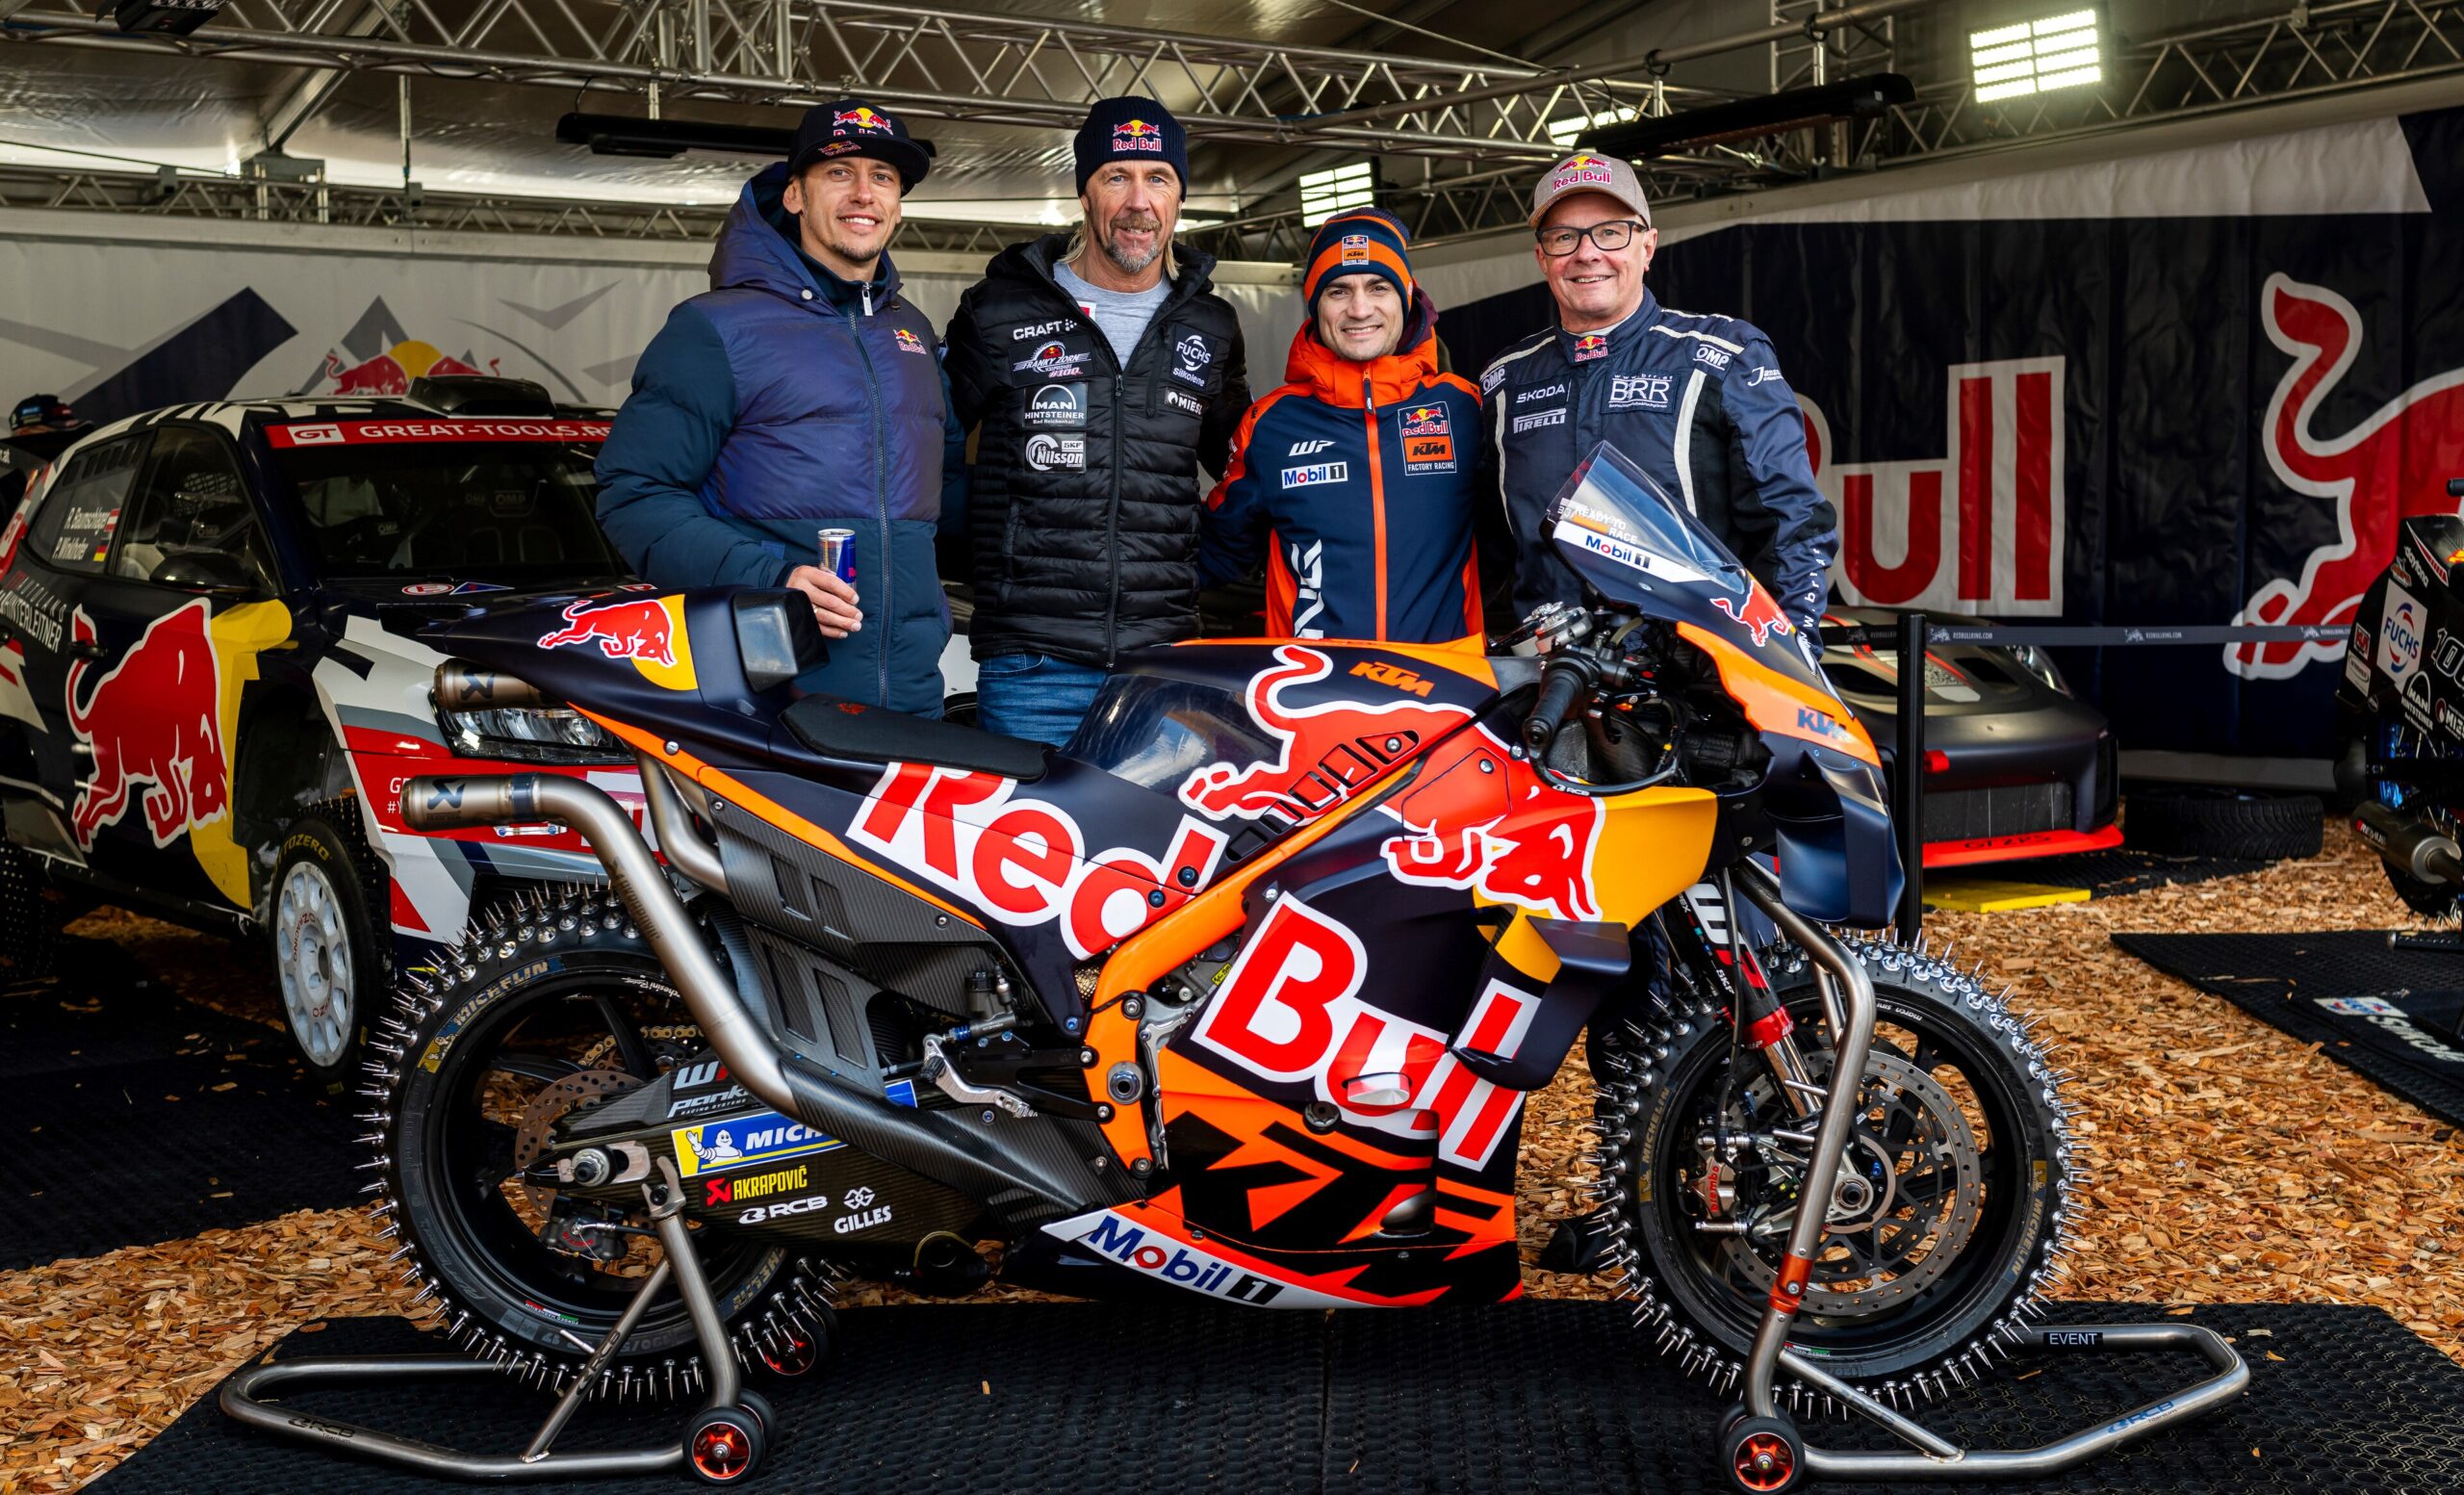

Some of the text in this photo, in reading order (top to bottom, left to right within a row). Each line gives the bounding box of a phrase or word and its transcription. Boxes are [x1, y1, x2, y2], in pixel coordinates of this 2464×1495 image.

[1114, 137, 1162, 151] Red Bull
[1553, 169, 1611, 192] Red Bull
[1014, 321, 1063, 340] CRAFT
[1176, 342, 1212, 364] FUCHS
[1575, 347, 1608, 363] Red Bull
[1696, 348, 1730, 367] OMP
[1173, 368, 1205, 387] silkolene
[1483, 368, 1505, 392] OMP
[1516, 384, 1566, 403] SKODA
[1610, 380, 1670, 400] BRR
[1036, 401, 1073, 410] MAN
[1402, 421, 1449, 436] Red Bull
[1513, 408, 1567, 434] PIRELLI
[1037, 451, 1084, 464] Nilsson
[1289, 440, 1336, 456] WP
[1413, 443, 1446, 455] KTM
[1284, 467, 1327, 486] Mobil
[1408, 463, 1432, 472] FACTORY
[1800, 355, 2066, 617] ull
[1586, 535, 1632, 562] Mobil
[2383, 616, 2420, 660] FUCHS
[2431, 628, 2464, 697] 10
[1348, 661, 1434, 698] KTM
[2407, 686, 2429, 713] MAN
[846, 761, 1230, 961] Red
[1191, 891, 1542, 1172] Bull
[667, 1085, 750, 1119] pank
[680, 1105, 709, 1116] RACING
[1642, 1087, 1671, 1164] MICHELIN
[733, 1165, 808, 1200] AKRAPOVIČ
[1709, 1165, 1720, 1212] brembo
[769, 1196, 829, 1219] RCB
[834, 1205, 892, 1234] GILLES
[1089, 1215, 1231, 1293] Mobil
[2049, 1332, 2098, 1346] EVENT
[2129, 1401, 2175, 1425] RCB
